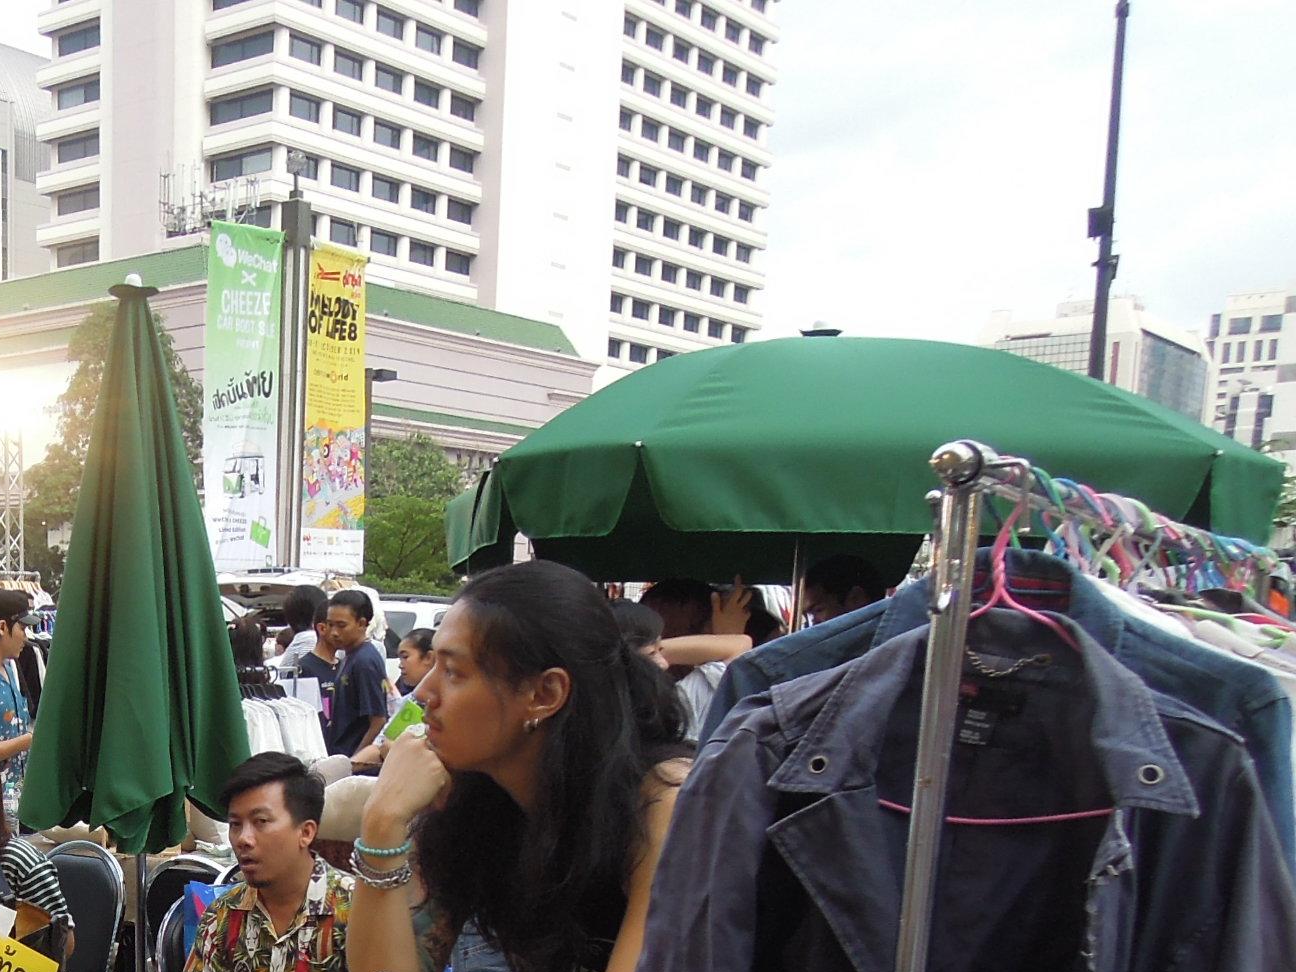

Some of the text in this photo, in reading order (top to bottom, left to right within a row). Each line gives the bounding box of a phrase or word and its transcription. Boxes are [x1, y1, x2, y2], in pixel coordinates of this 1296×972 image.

[237, 249, 278, 273] WeChat
[221, 289, 271, 315] CHEEZE
[309, 290, 360, 321] MELODY
[217, 314, 233, 330] CAR
[235, 317, 254, 333] BOOT
[308, 309, 323, 334] OF
[325, 317, 347, 340] LIFE
